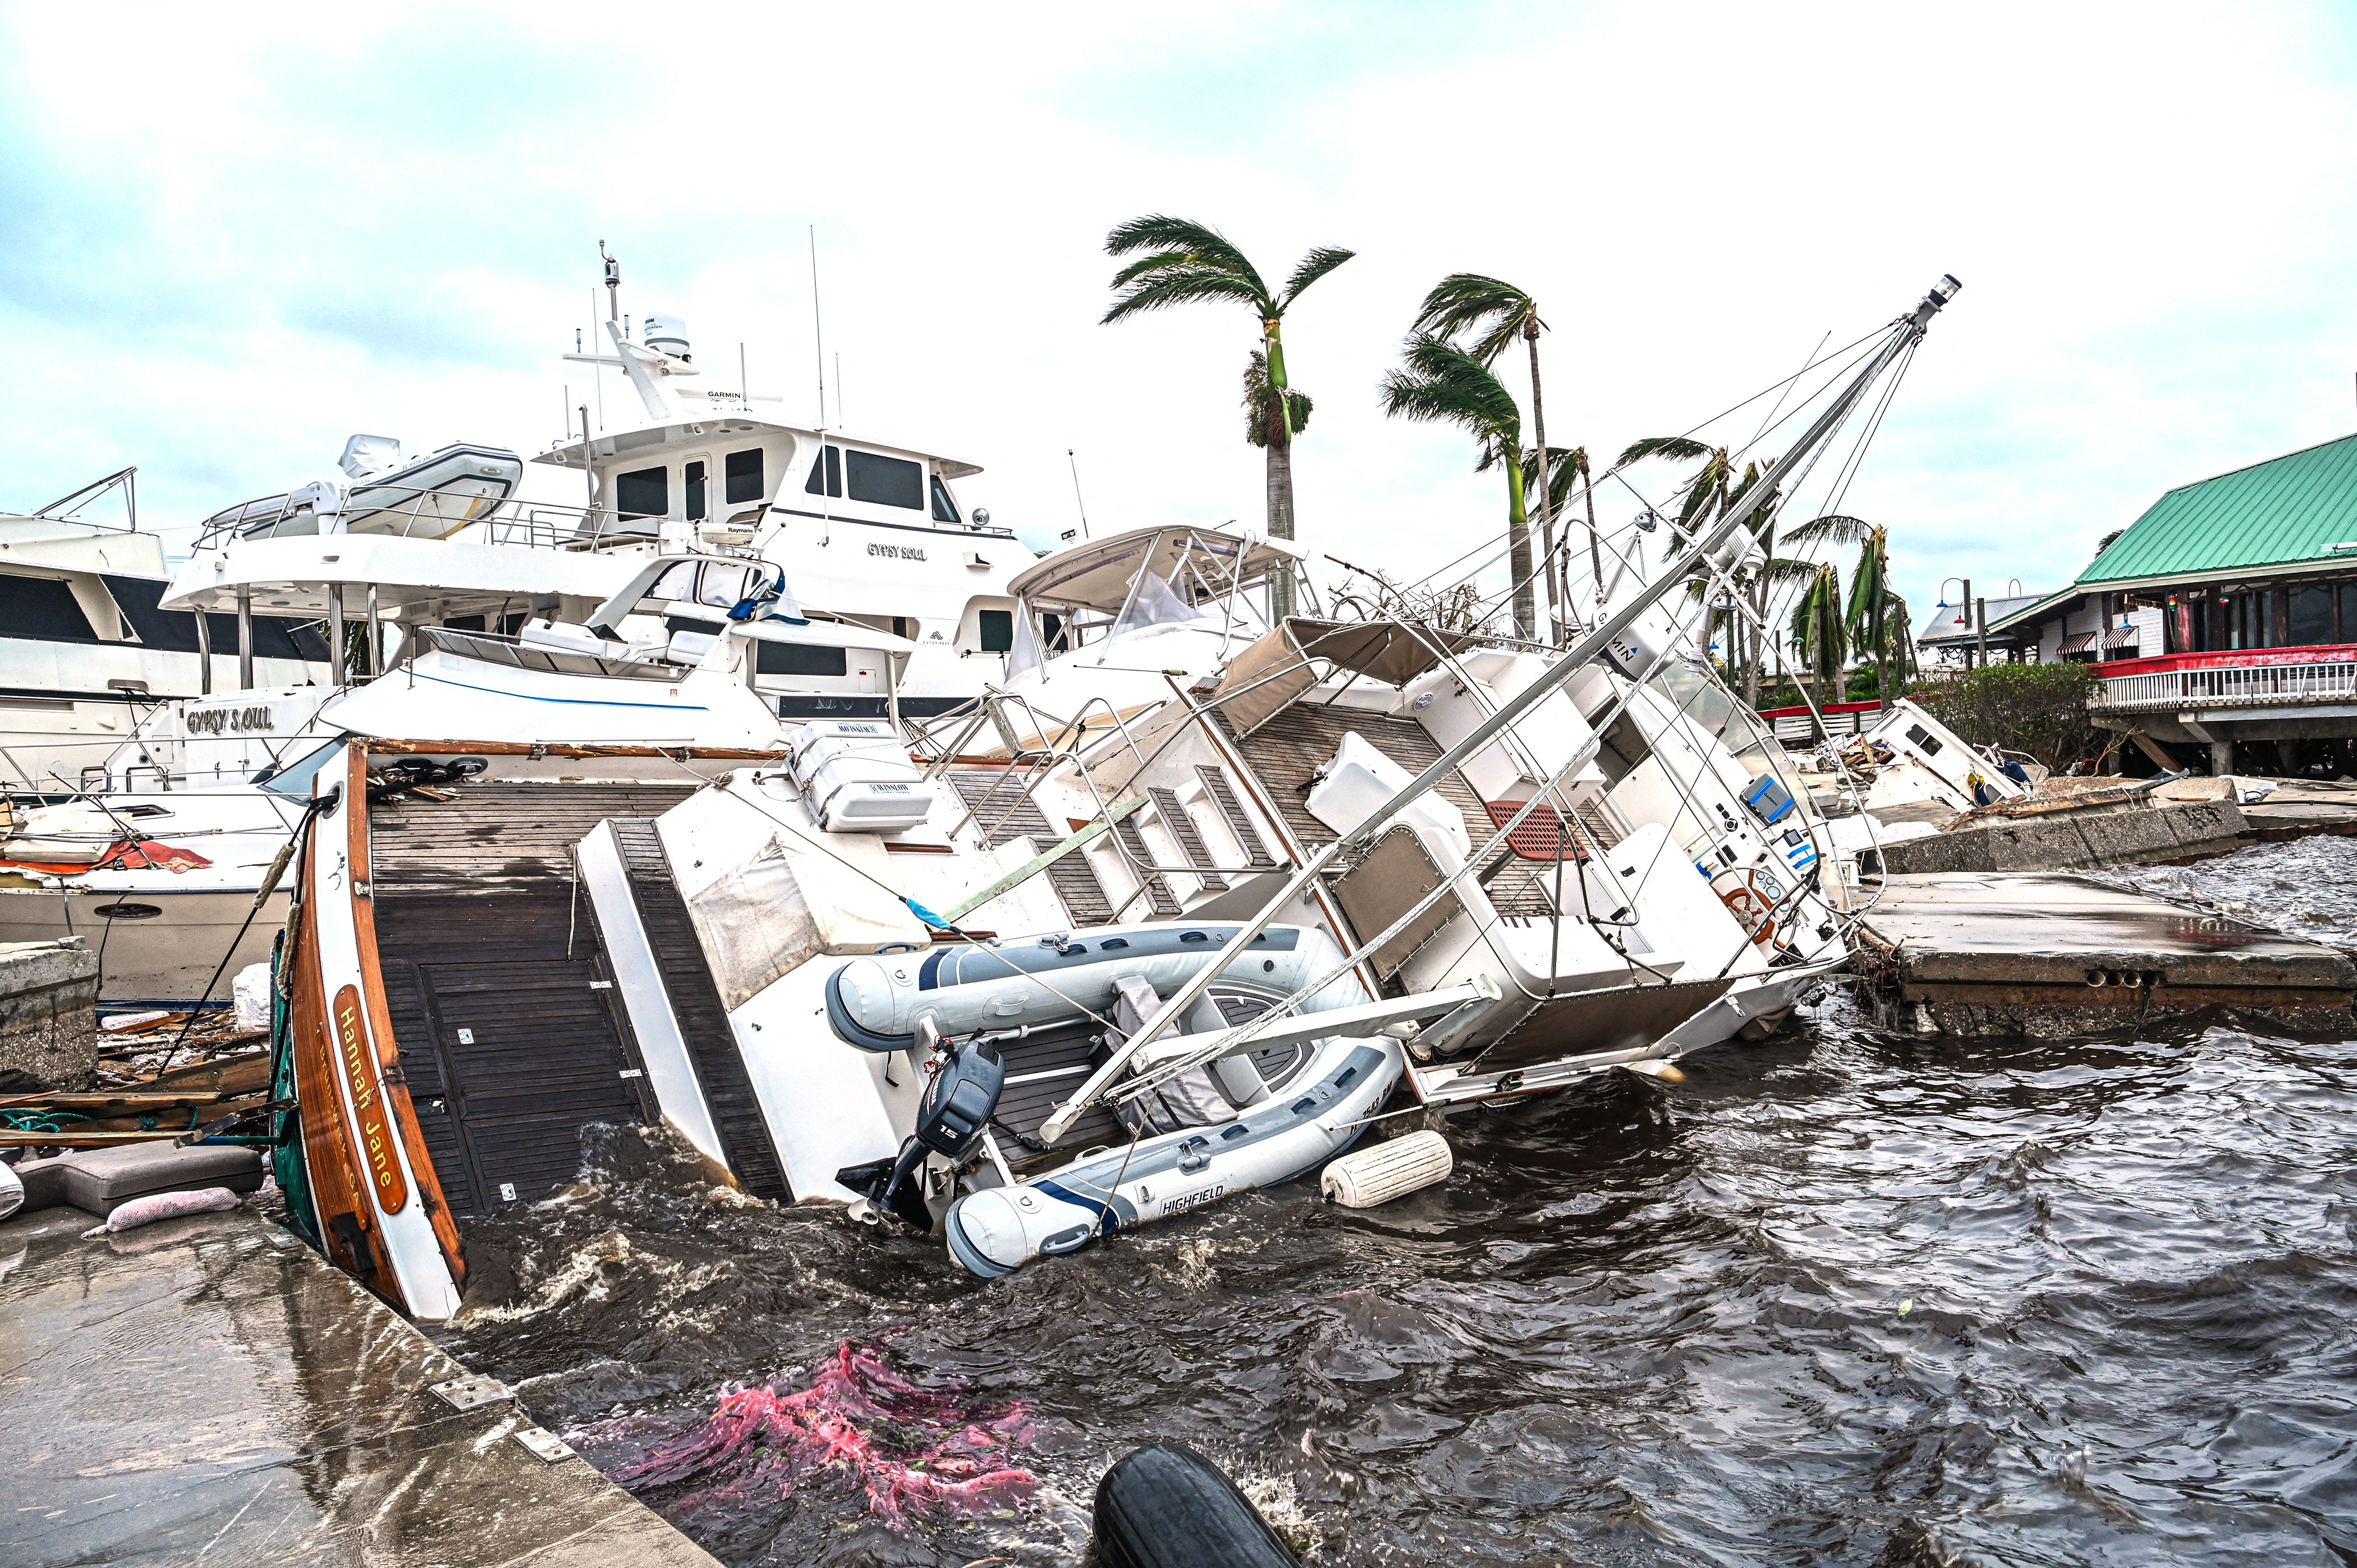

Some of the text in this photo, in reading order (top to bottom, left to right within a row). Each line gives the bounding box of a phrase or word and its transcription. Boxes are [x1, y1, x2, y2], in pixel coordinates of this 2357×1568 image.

[867, 542, 928, 562] GYPSY SOUL
[1598, 613, 1634, 662] GMIN
[187, 709, 227, 734] GYPSY
[1764, 792, 1778, 806] GARMIN
[340, 1006, 391, 1188] Hannah Jane
[939, 1125, 959, 1139] 15
[349, 1172, 359, 1207] GA
[1163, 1185, 1223, 1214] HIGHFIELD
